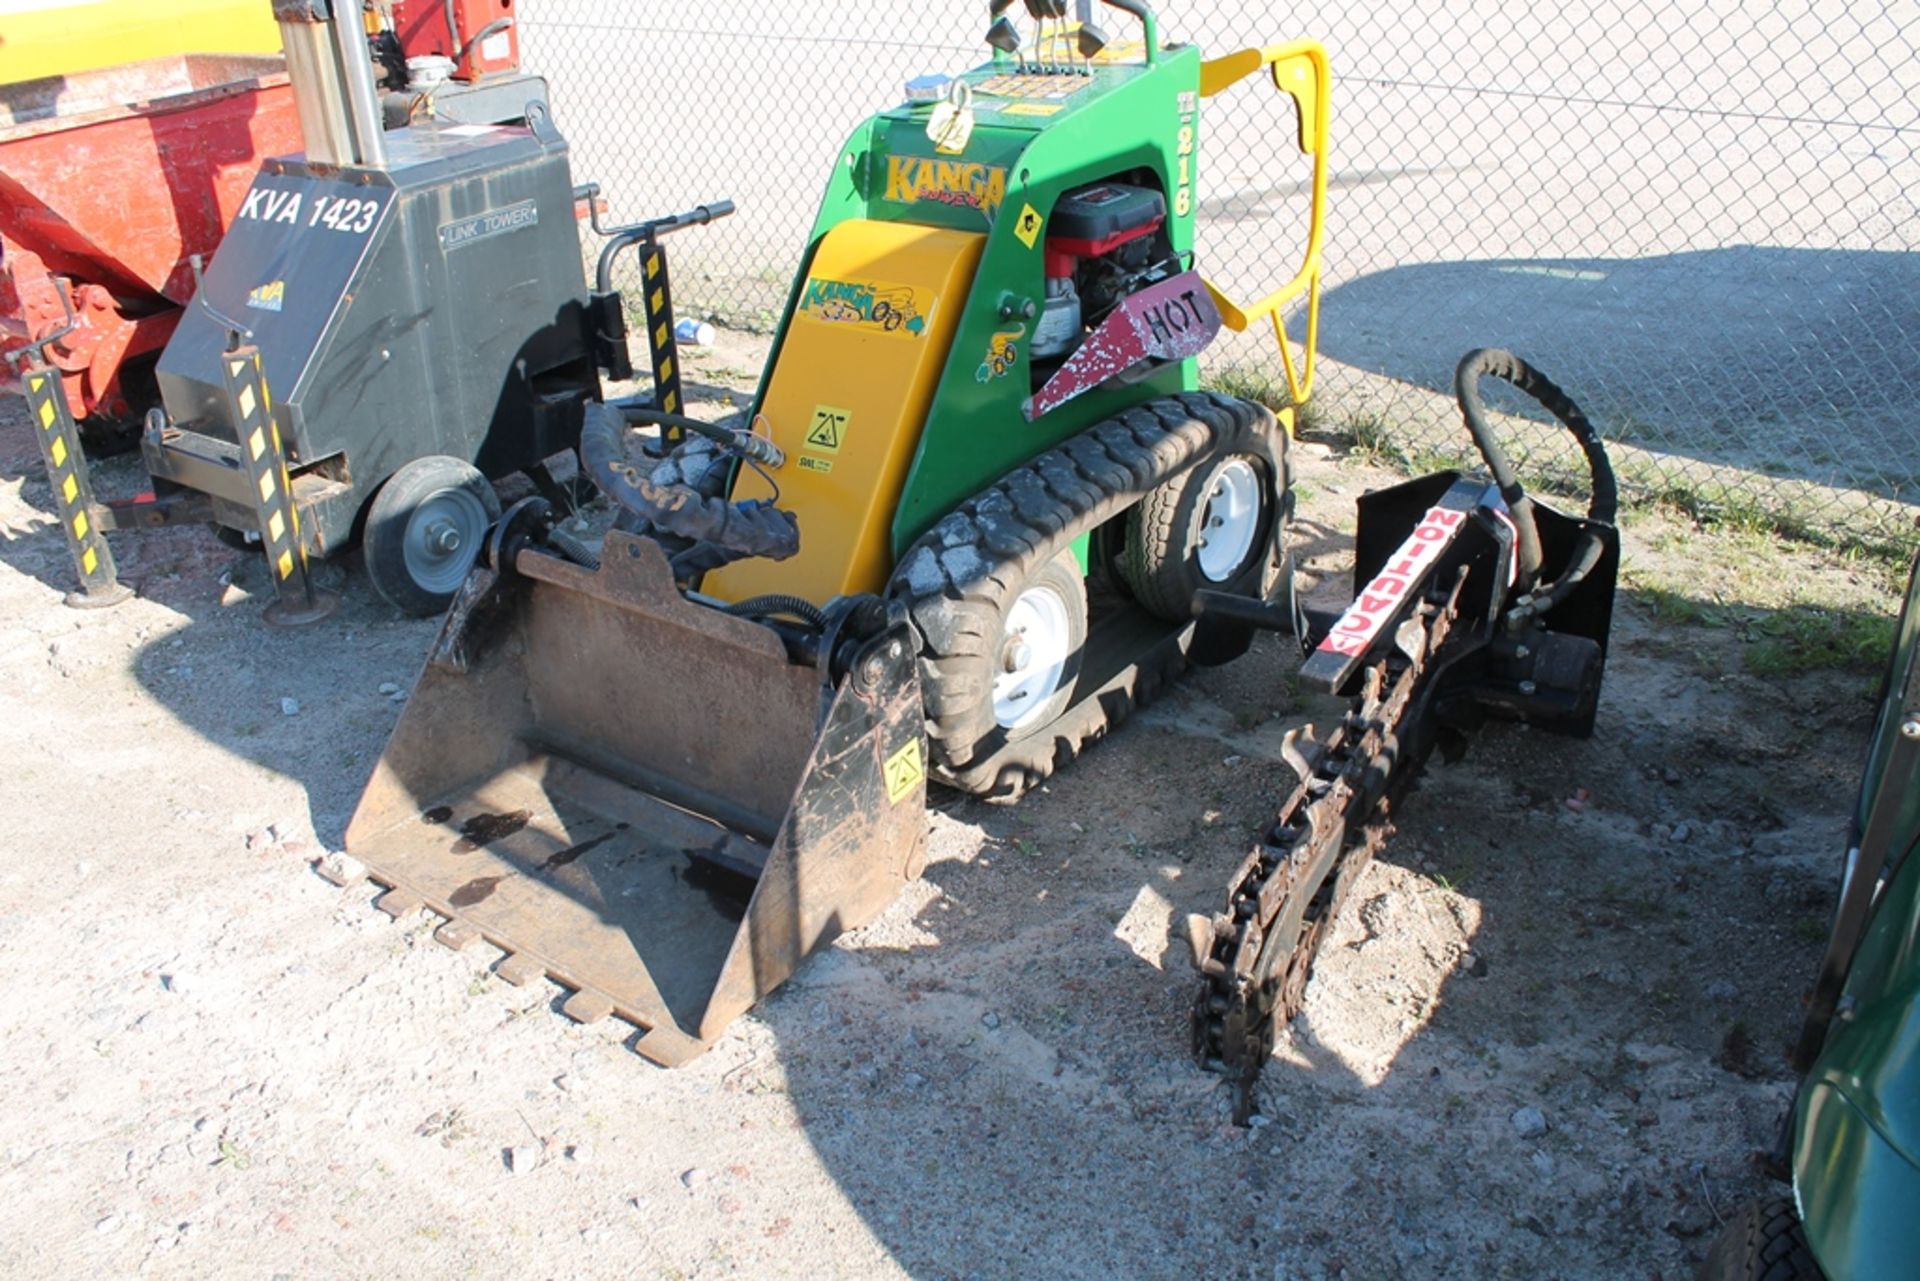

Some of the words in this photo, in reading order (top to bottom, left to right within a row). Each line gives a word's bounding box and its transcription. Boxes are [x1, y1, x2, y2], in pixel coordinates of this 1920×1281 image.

[882, 154, 1007, 211] KANGA
[239, 188, 303, 225] KVA
[309, 196, 379, 233] 1423
[448, 221, 478, 242] LINK
[484, 208, 530, 231] TOWER
[1142, 290, 1203, 344] HOT
[1341, 509, 1460, 633] CAUTION
